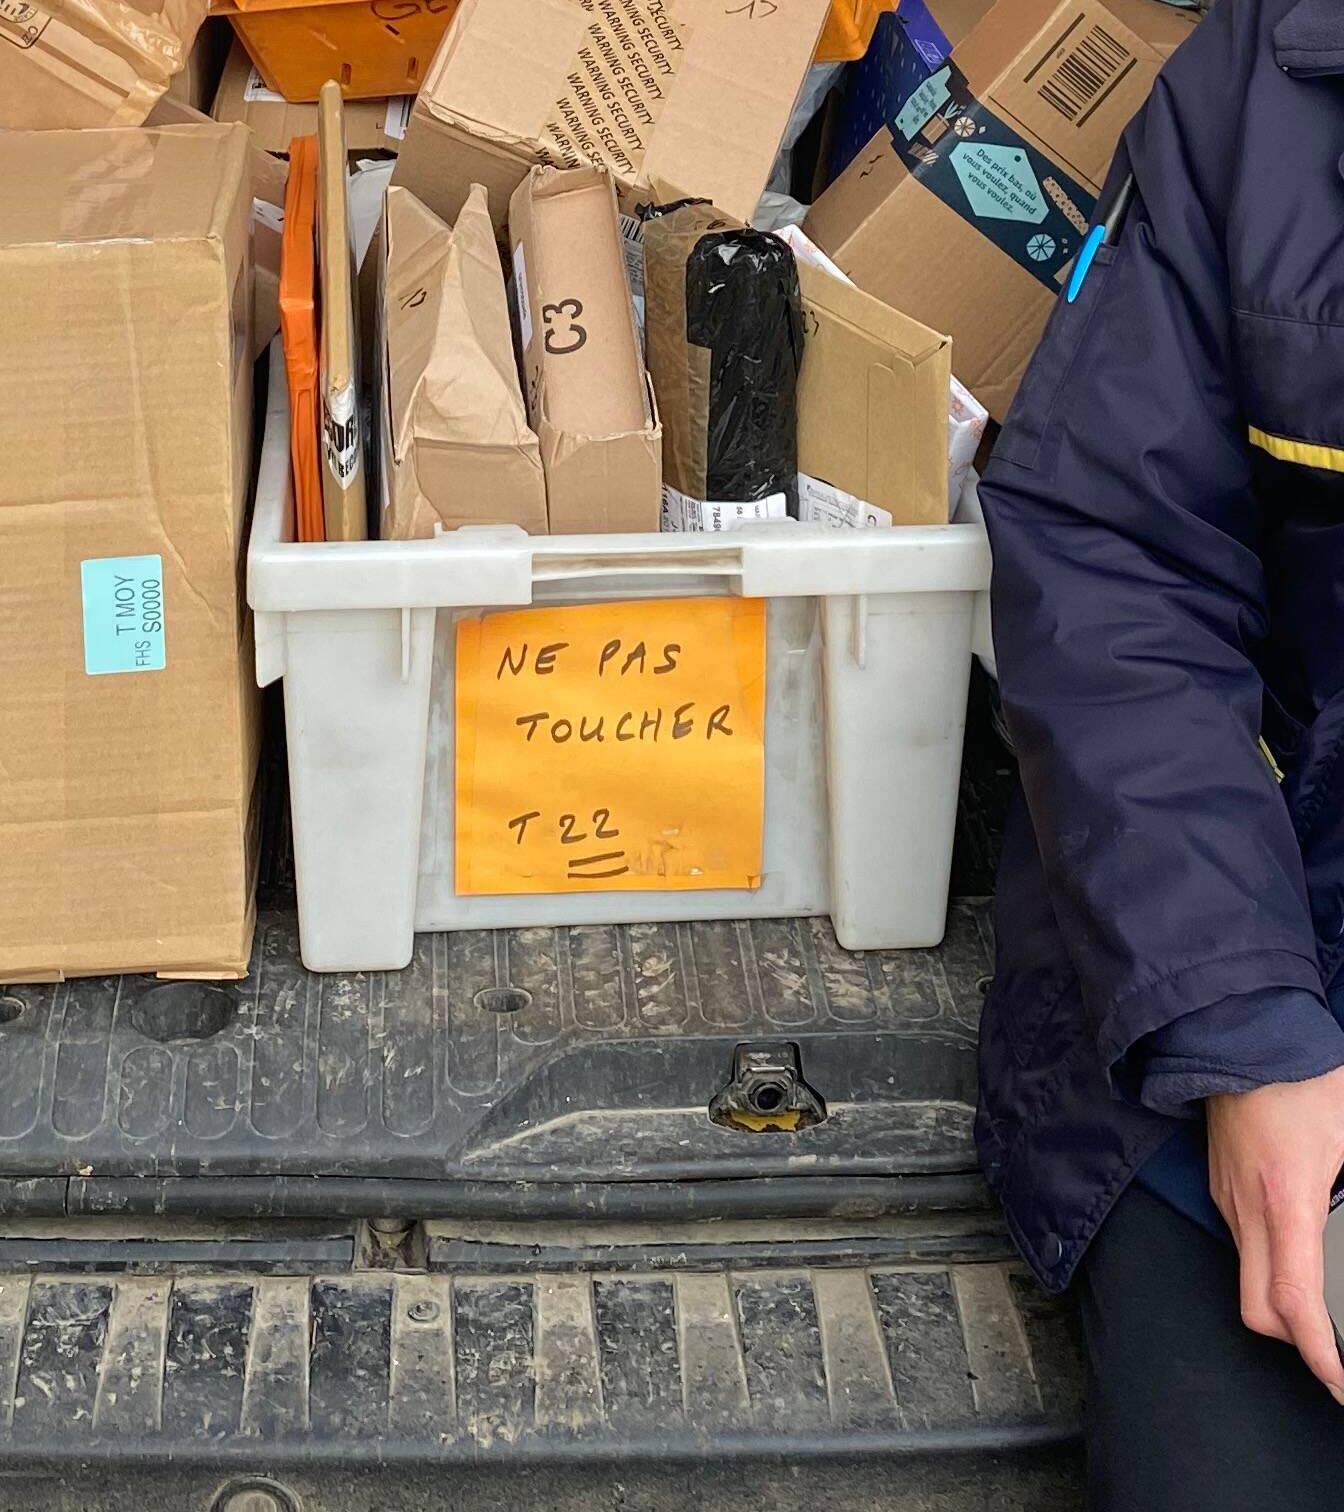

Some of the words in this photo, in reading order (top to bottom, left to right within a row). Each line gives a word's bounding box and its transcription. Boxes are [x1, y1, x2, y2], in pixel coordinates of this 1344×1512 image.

[598, 0, 636, 51] WARNING
[627, 51, 666, 100] SECURITY
[637, 26, 676, 76] SECURITY
[588, 23, 626, 76] WARNING
[617, 76, 656, 126] SECURITY
[577, 47, 616, 101] WARNING
[607, 101, 646, 151] SECURITY
[556, 97, 595, 151] WARNING
[567, 72, 605, 126] WARNING
[597, 126, 636, 175] SECURITY
[962, 152, 982, 171] vous
[1009, 192, 1037, 215] quand
[968, 171, 988, 191] vous
[976, 148, 993, 165] Des
[990, 162, 1009, 179] prix
[542, 298, 587, 355] C3
[114, 575, 136, 618] MOY
[115, 623, 136, 636] T
[134, 640, 151, 666] FHS
[496, 641, 570, 681] NE
[598, 638, 682, 678] PAS
[515, 701, 734, 744] TOUCHER
[508, 811, 541, 845] T
[559, 808, 620, 845] 22
